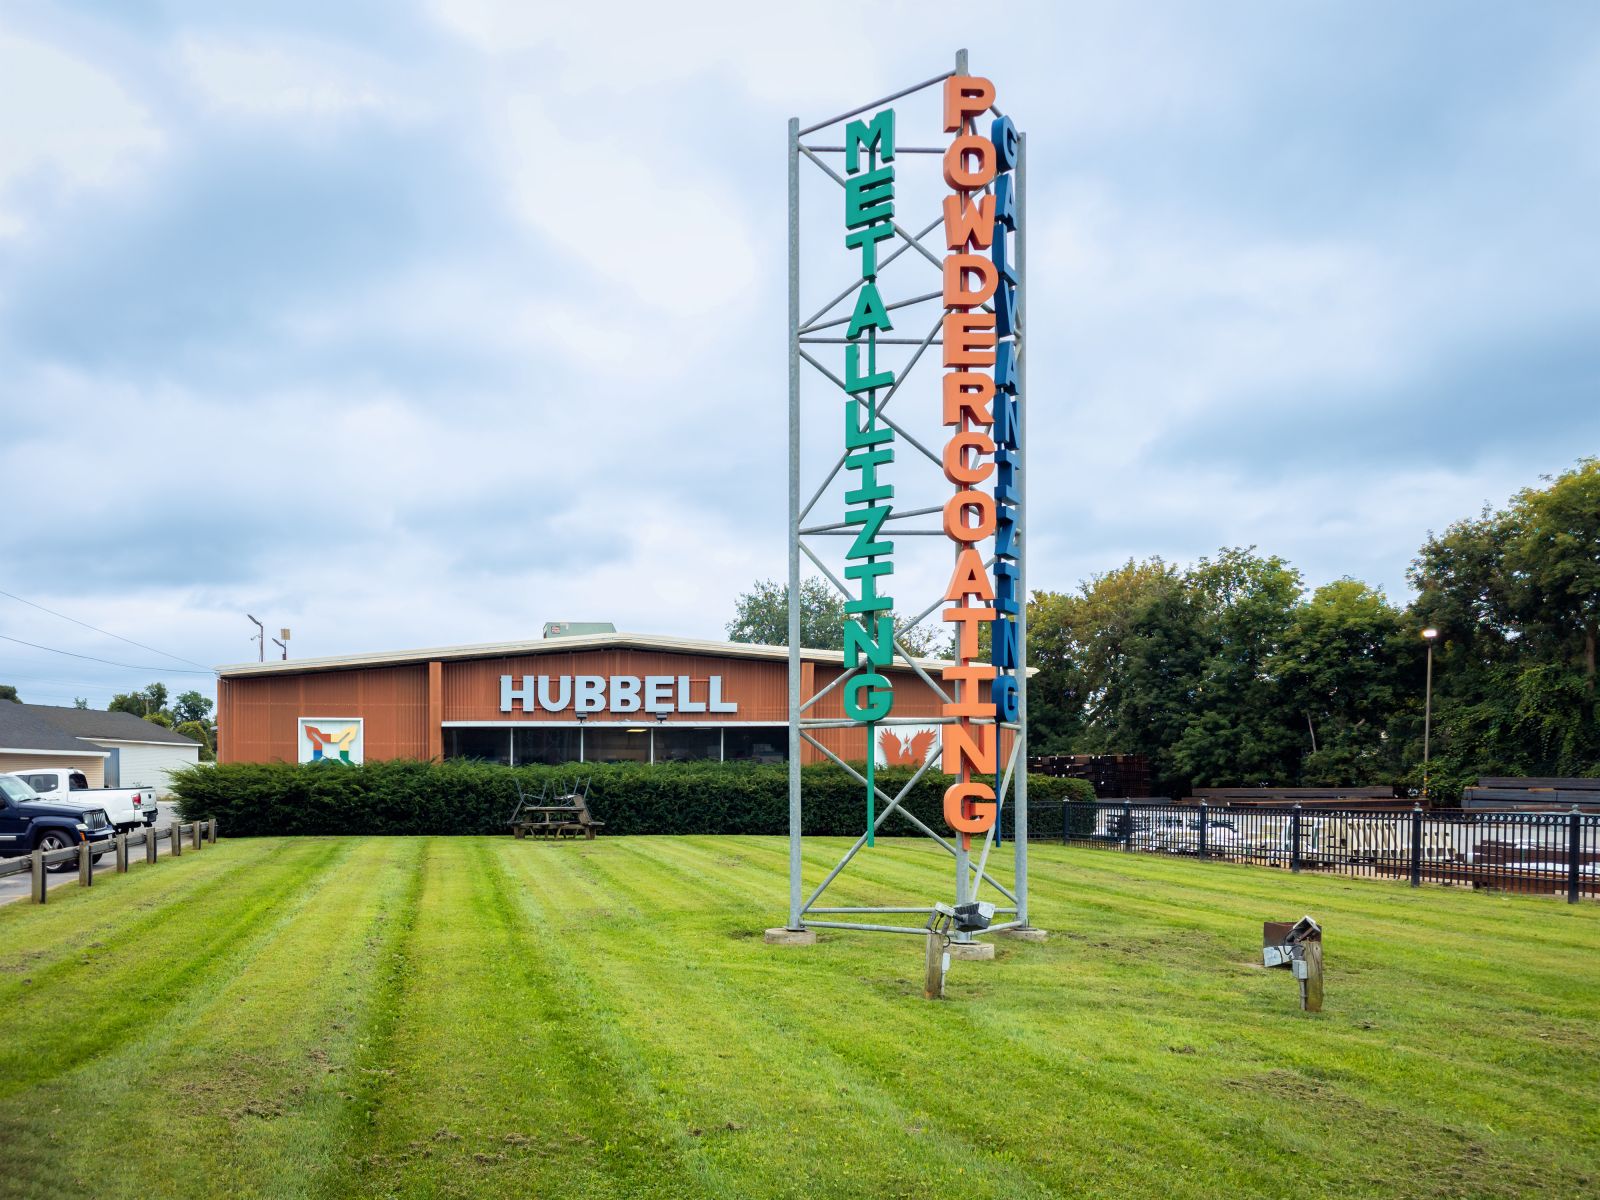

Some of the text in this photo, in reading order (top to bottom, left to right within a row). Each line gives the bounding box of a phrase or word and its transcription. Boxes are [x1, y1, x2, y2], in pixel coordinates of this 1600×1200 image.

[500, 675, 738, 713] HUBBELL
[844, 107, 896, 722] METALLIZING
[991, 114, 1020, 722] GALVANIZING
